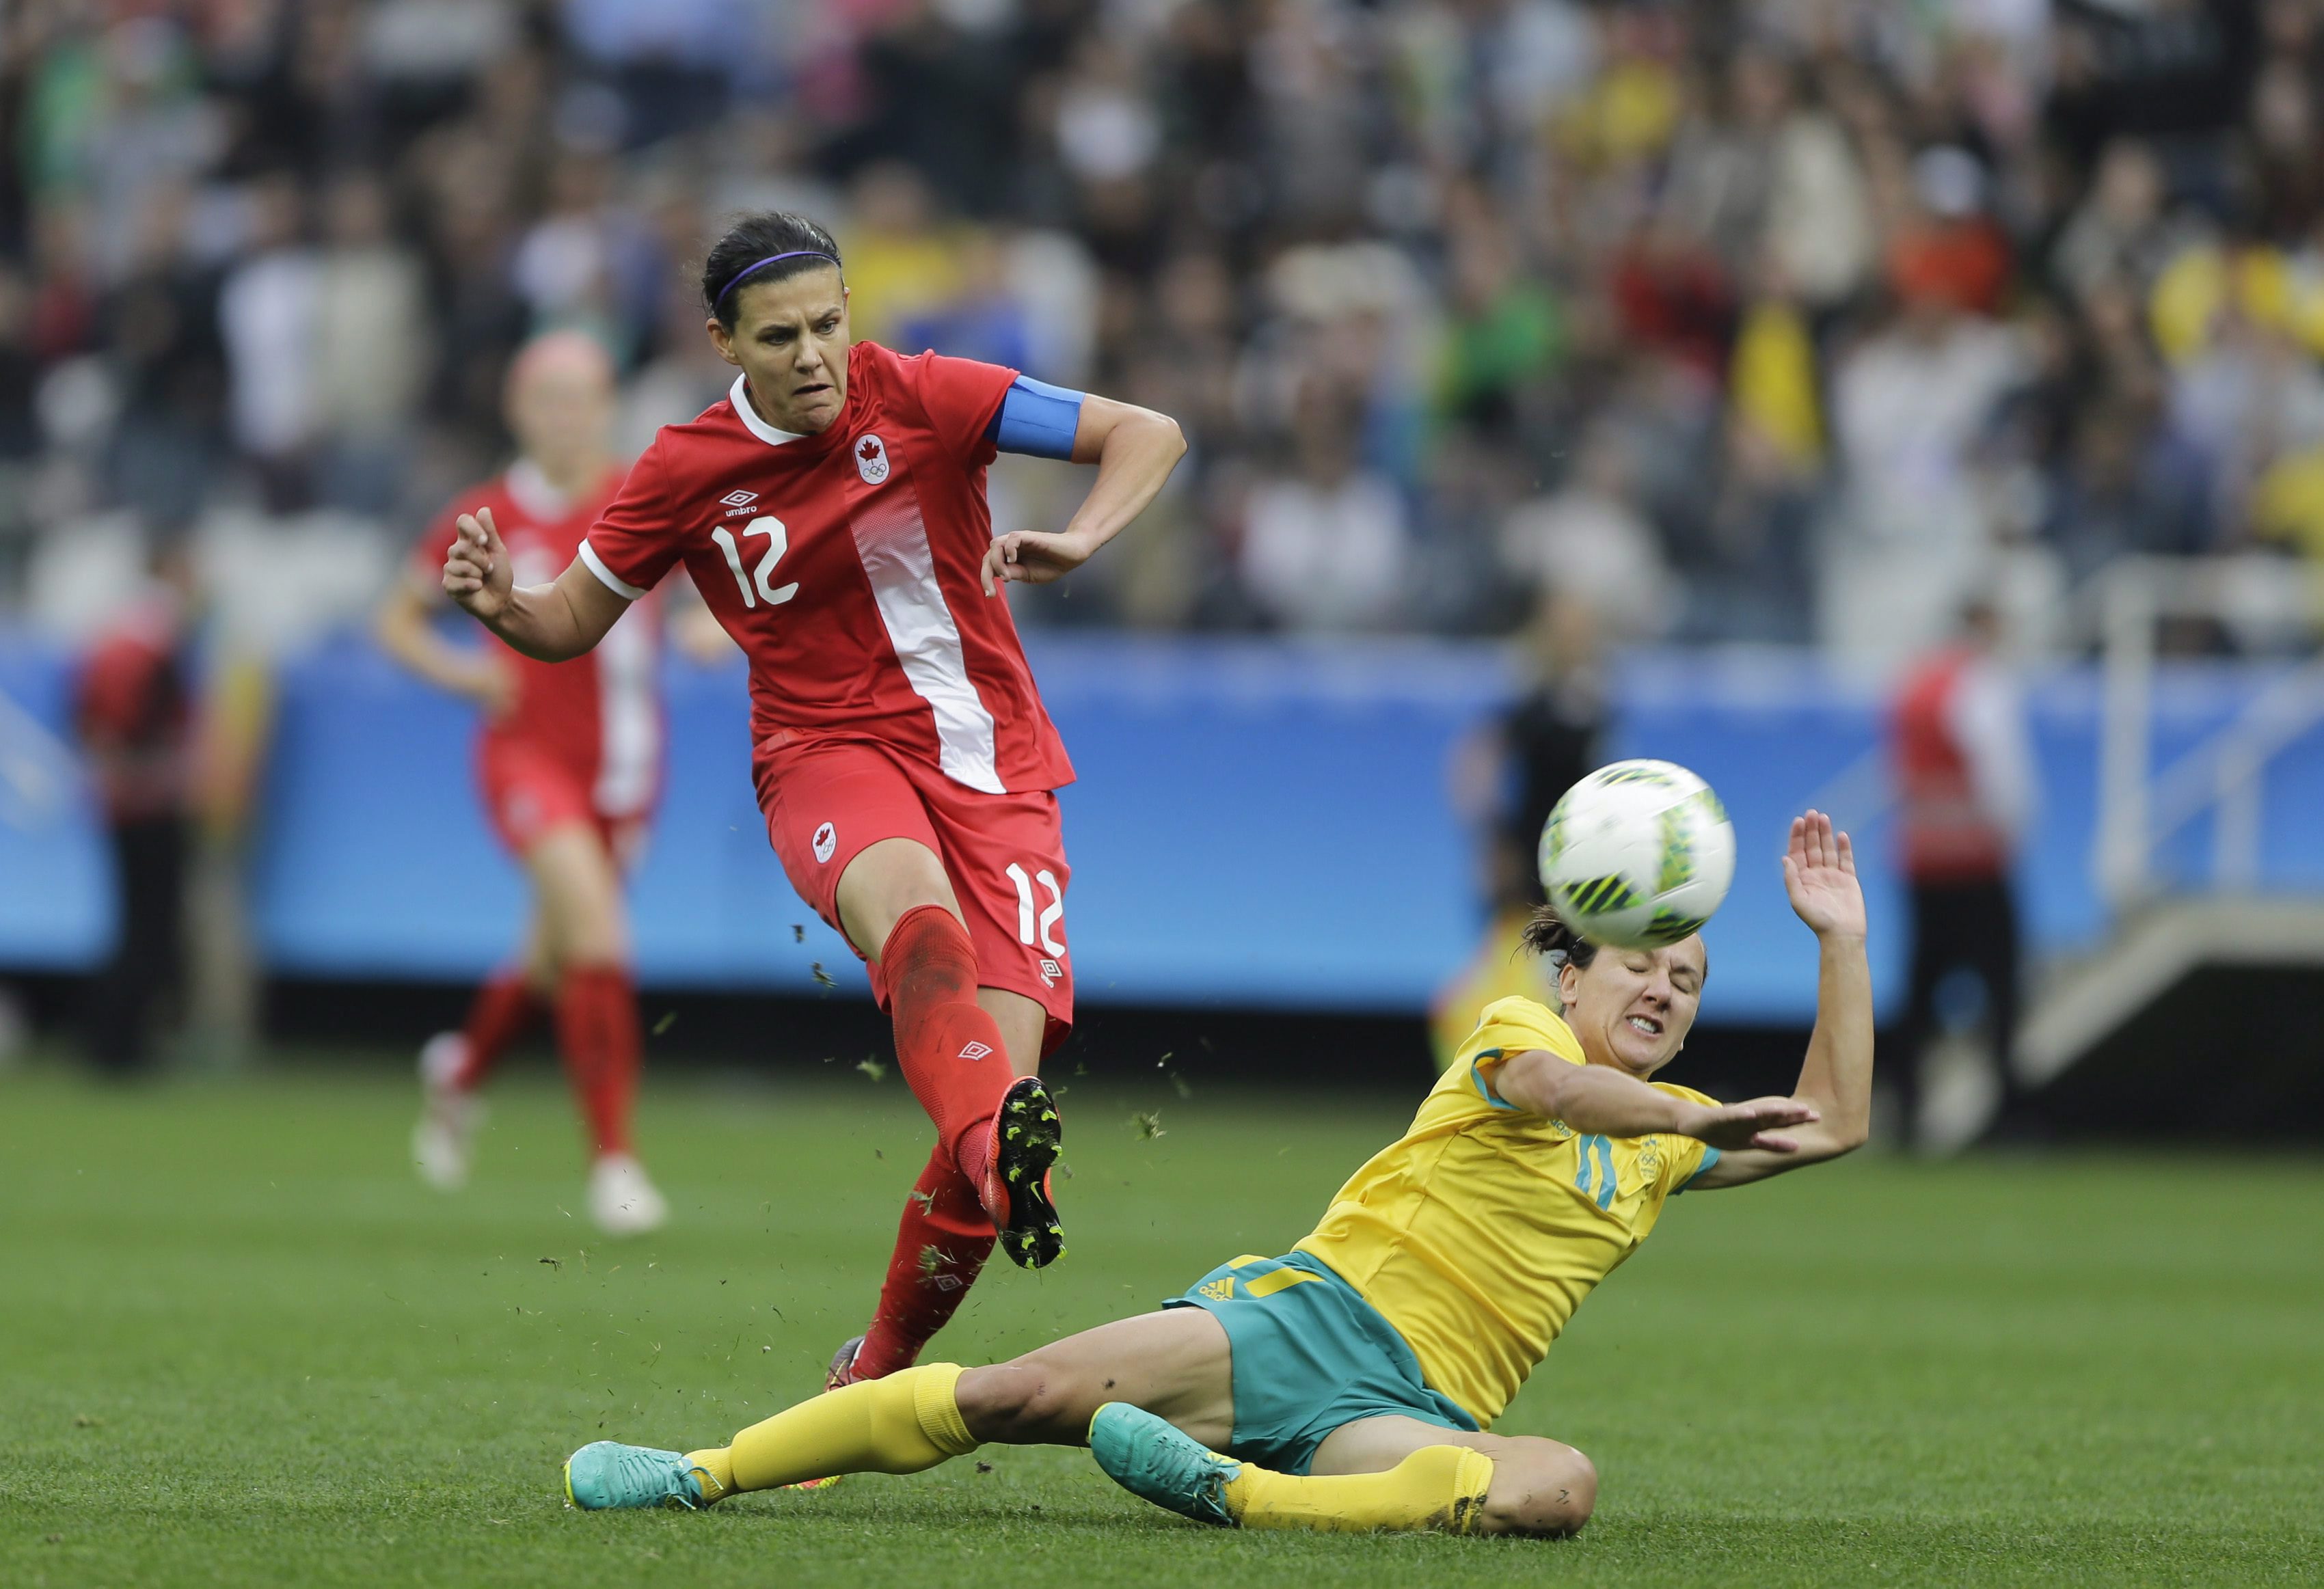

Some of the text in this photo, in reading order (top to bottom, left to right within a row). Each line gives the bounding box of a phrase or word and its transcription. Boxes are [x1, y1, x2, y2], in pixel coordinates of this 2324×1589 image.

[725, 506, 757, 516] umbro
[712, 516, 799, 608] 12
[1005, 863, 1065, 958] 12
[1575, 1134, 1617, 1211] 11
